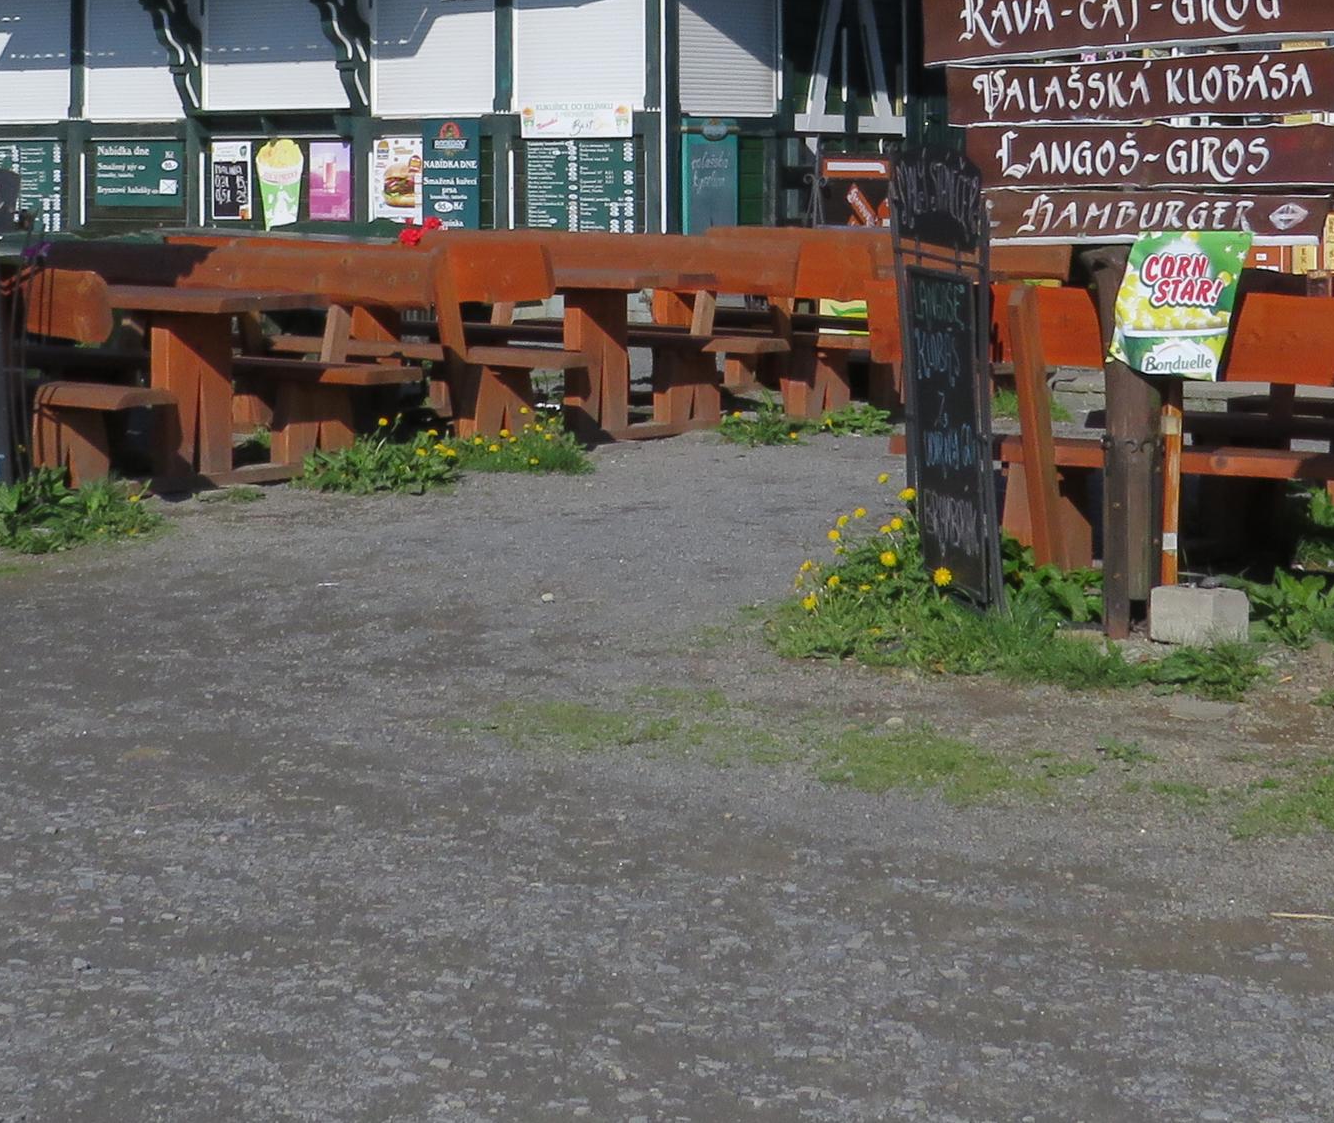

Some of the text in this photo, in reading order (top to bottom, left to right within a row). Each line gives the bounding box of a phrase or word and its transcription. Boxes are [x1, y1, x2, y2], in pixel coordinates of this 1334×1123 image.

[972, 54, 1313, 120] VALAŠSKÁ KLOBÁSA
[97, 145, 150, 156] Nabídka dne
[423, 158, 460, 169] NABÍDKA
[460, 159, 478, 169] DNE
[996, 129, 1140, 179] LANGOŠ
[1166, 135, 1270, 183] GIROS
[1016, 194, 1256, 234] HAMBURGER
[1143, 253, 1208, 284] CORN
[1153, 278, 1224, 305] STAR!
[1145, 354, 1212, 372] Bonduelle
